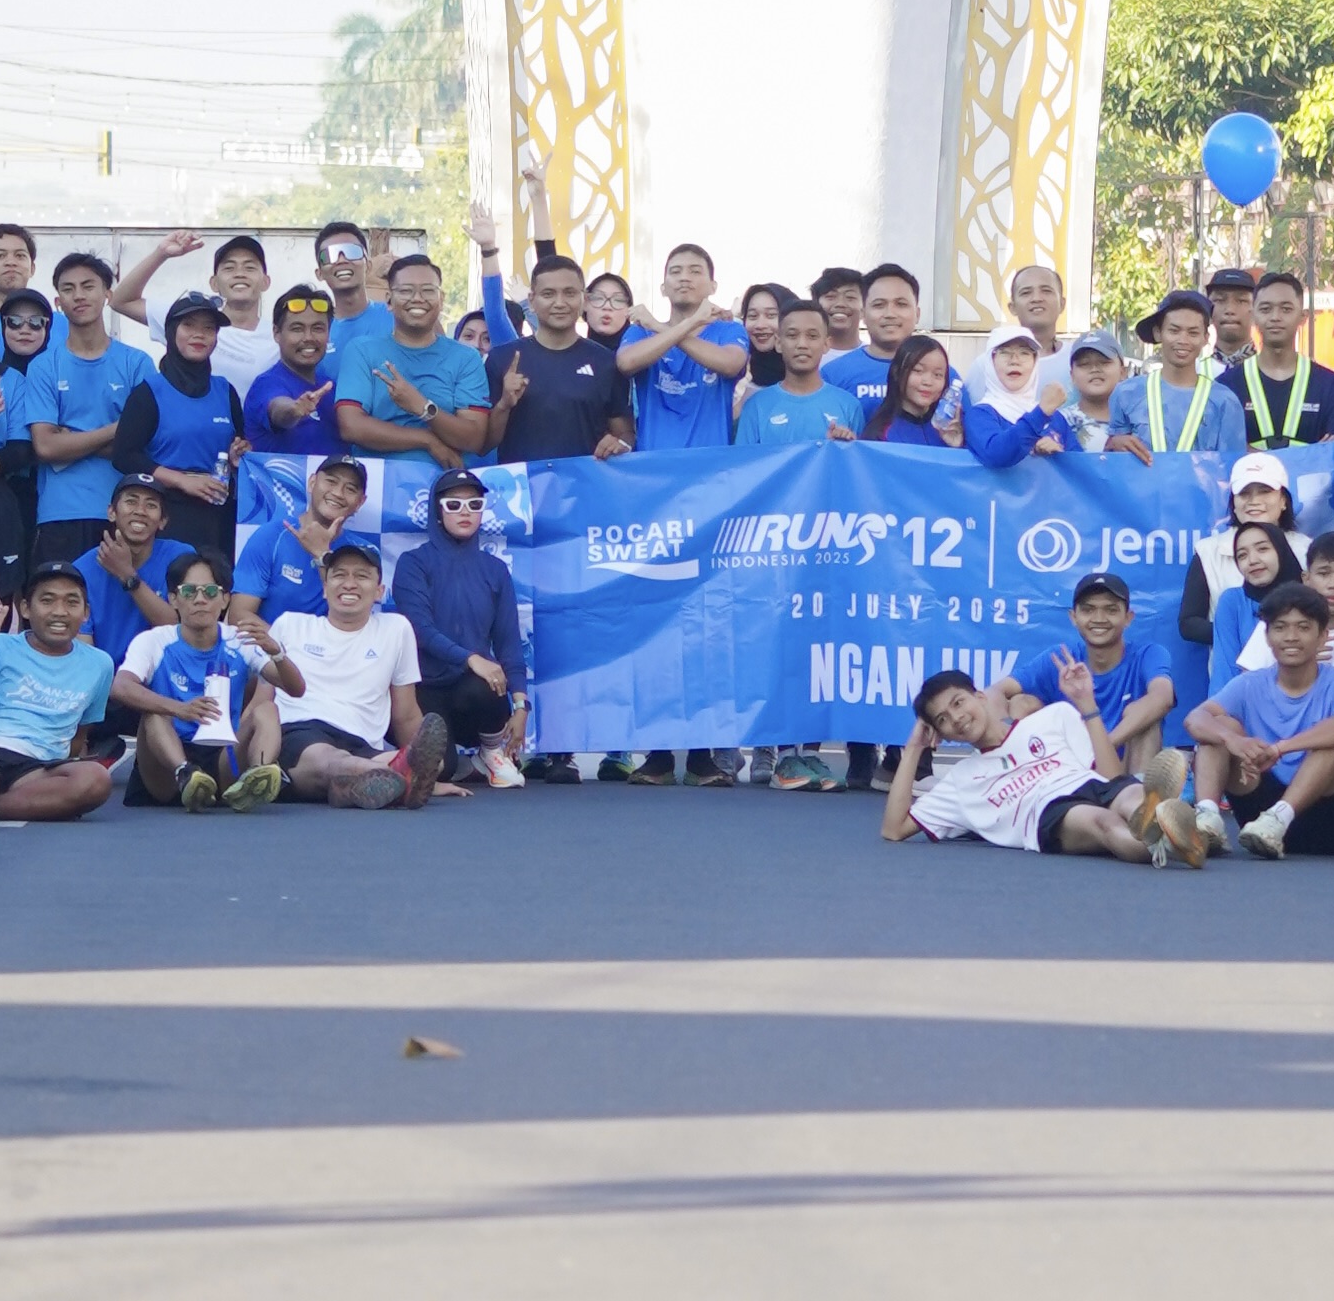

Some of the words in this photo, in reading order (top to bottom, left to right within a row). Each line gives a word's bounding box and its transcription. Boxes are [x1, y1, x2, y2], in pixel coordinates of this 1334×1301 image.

[587, 518, 695, 544] POCARI
[587, 539, 684, 563] SWEAT
[711, 554, 807, 569] INDONESIA
[815, 551, 850, 566] 2025
[791, 591, 824, 619] 20
[847, 592, 923, 620] JULY
[947, 596, 1030, 625] 2025
[987, 758, 1061, 808] Emirates
